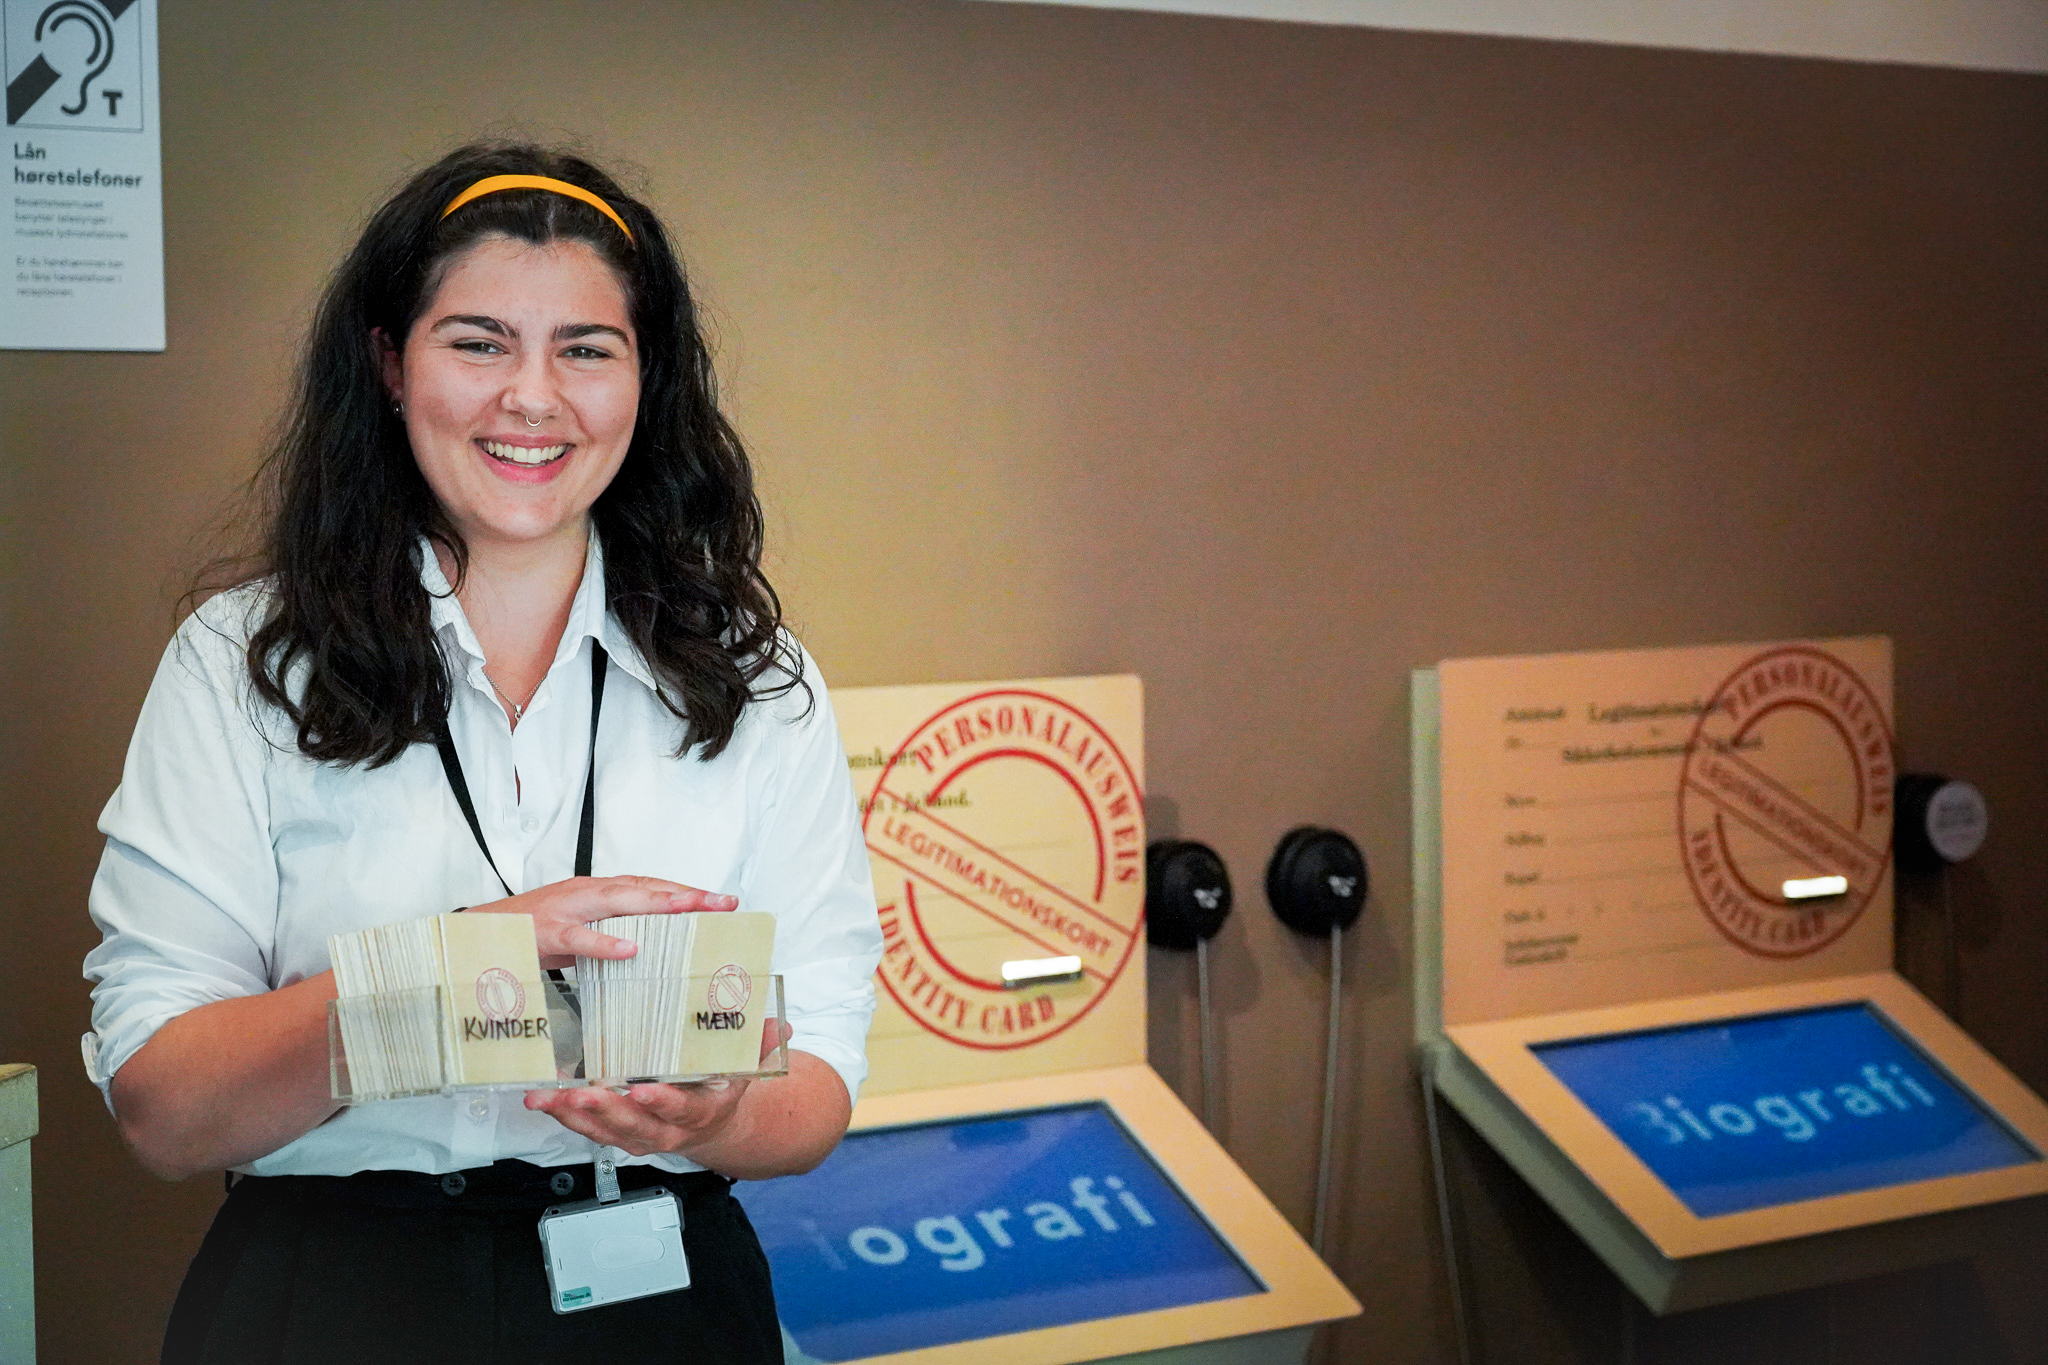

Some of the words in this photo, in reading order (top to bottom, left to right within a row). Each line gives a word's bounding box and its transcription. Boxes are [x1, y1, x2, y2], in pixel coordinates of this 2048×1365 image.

[102, 89, 123, 116] T
[14, 141, 46, 160] Lån
[14, 166, 143, 188] høretelefoner
[916, 705, 1139, 884] PERSONALAUSWEIS
[882, 816, 1112, 956] LEGITIMATIONSKORT
[878, 903, 968, 1029] IDENTITY
[980, 994, 1057, 1035] CARD
[463, 1016, 549, 1042] KVINDER
[696, 1011, 746, 1032] MÆND
